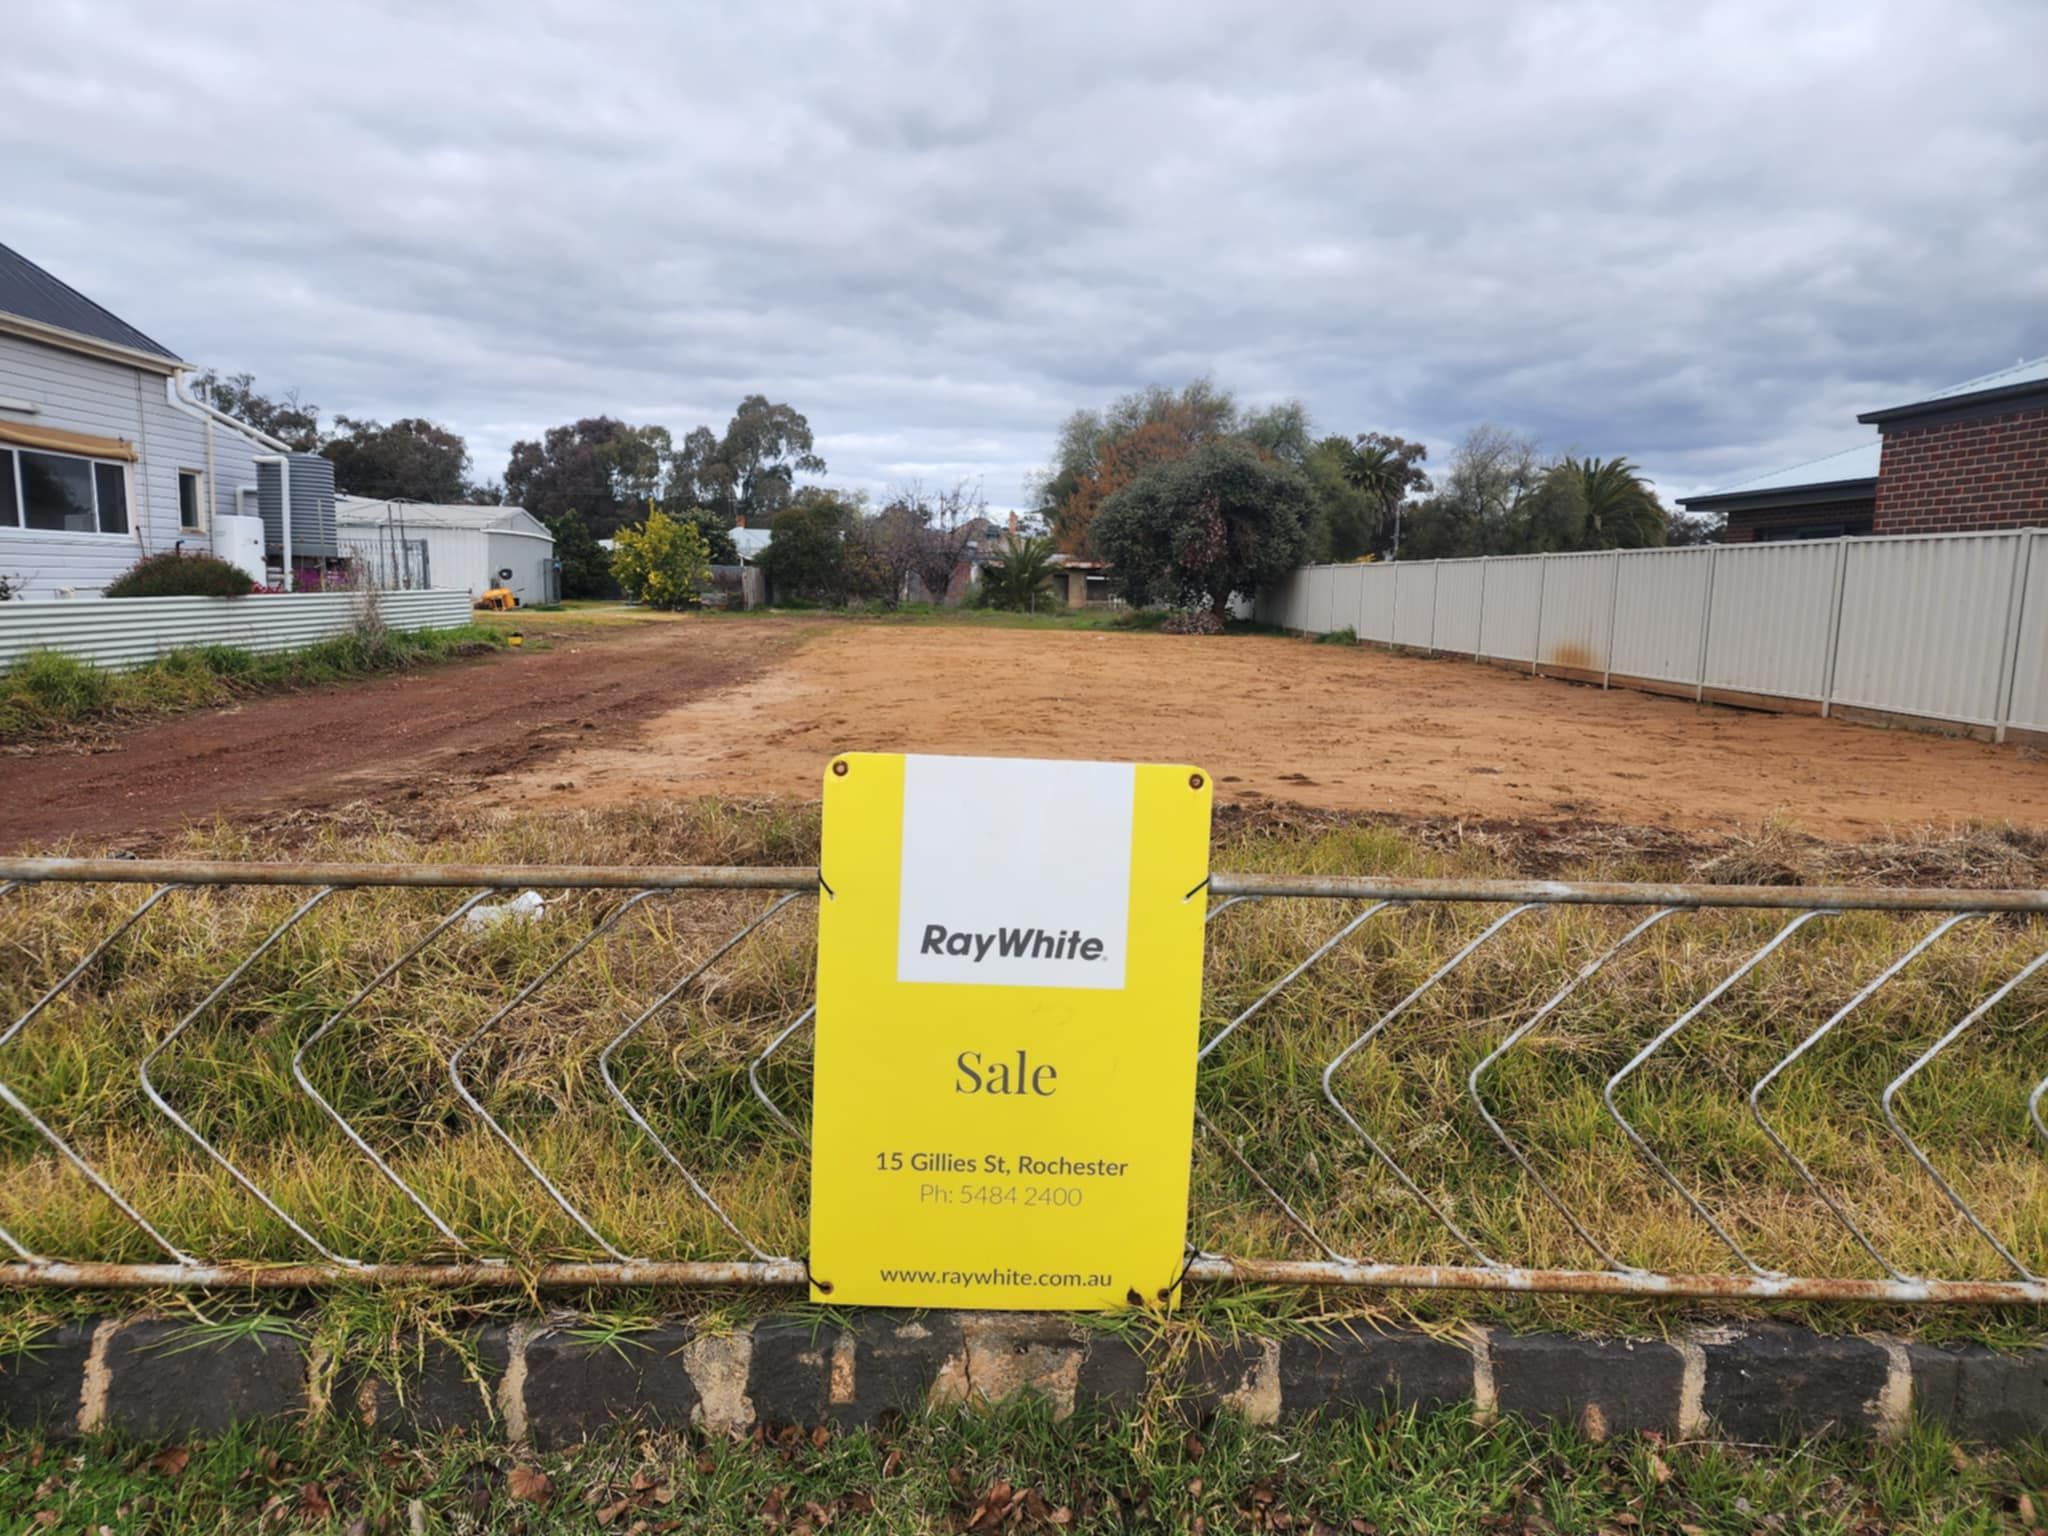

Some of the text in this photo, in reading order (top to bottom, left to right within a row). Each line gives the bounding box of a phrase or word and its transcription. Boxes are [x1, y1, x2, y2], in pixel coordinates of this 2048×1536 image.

[955, 1050, 1058, 1096] Sale
[876, 1152, 1128, 1177] 15 Gillies St, Rochester
[920, 1184, 1083, 1207] Ph: 5484 2400
[880, 1268, 1113, 1288] www.raywhite.com.au
